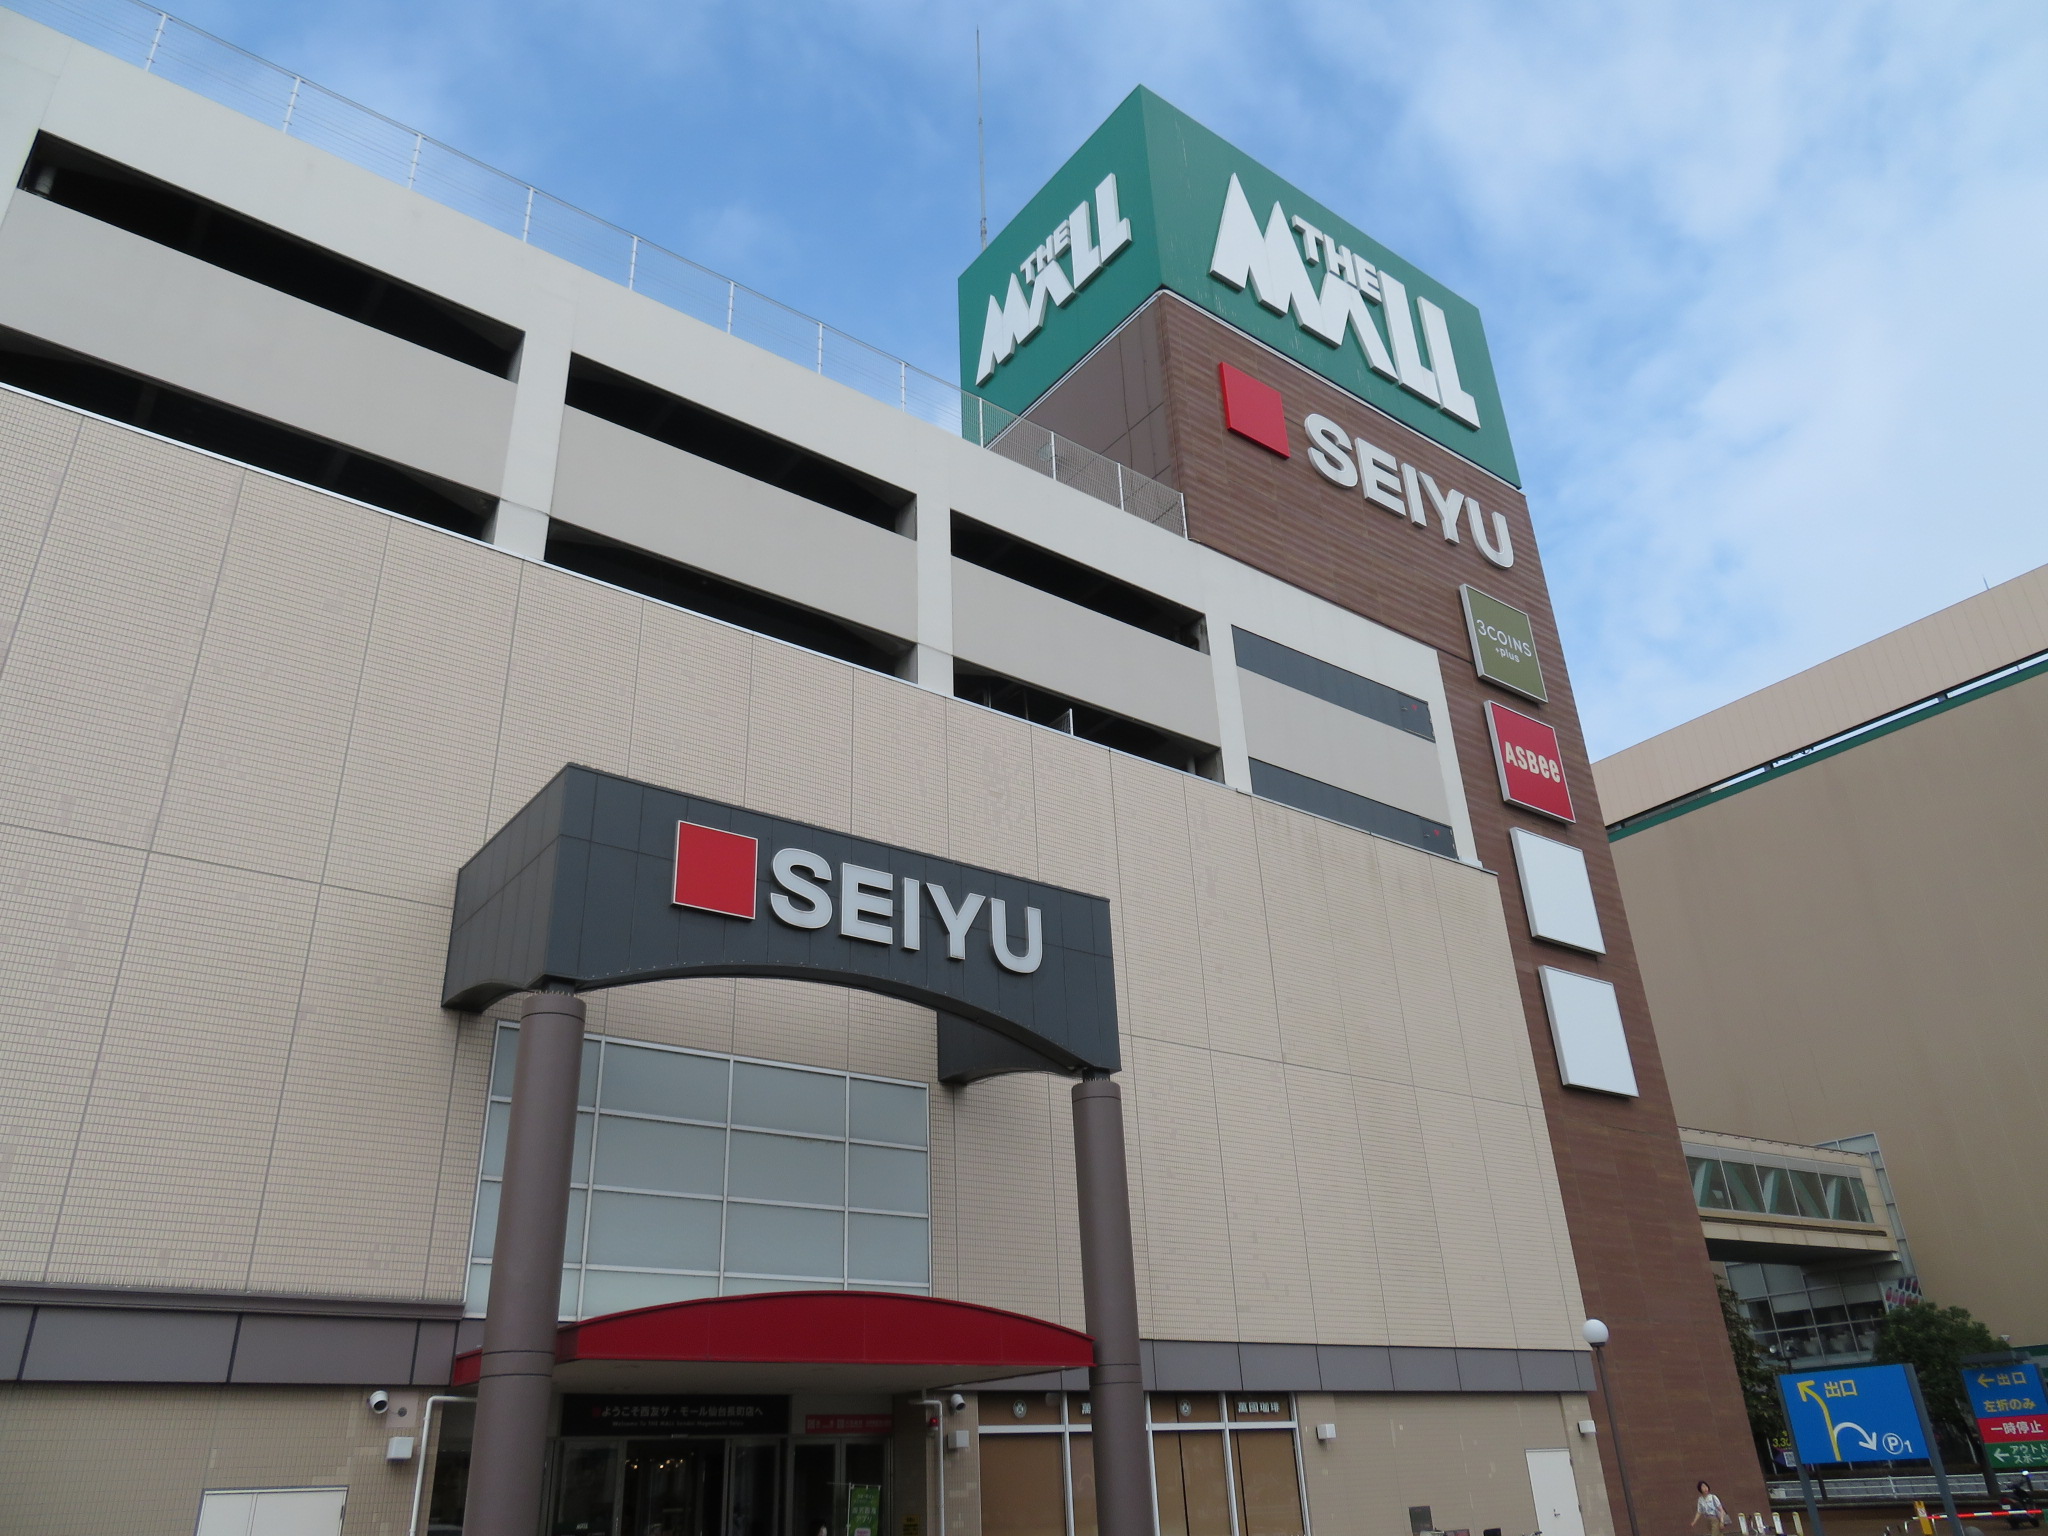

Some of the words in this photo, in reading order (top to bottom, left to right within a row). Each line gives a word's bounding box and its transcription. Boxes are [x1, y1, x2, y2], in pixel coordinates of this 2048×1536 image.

[1020, 219, 1071, 284] THE
[1292, 215, 1383, 306] THE
[976, 173, 1132, 387] MALL
[1210, 173, 1481, 430] MALL
[1304, 413, 1514, 569] SEIYU
[1476, 619, 1532, 657] 3COINS
[1505, 741, 1561, 783] ASBee
[770, 847, 1043, 974] SEIYU
[1825, 1379, 1858, 1398] 出口
[1983, 1397, 2037, 1413] 左折のみ
[1996, 1371, 2027, 1386] 出口
[1990, 1420, 2044, 1435] 一時停止
